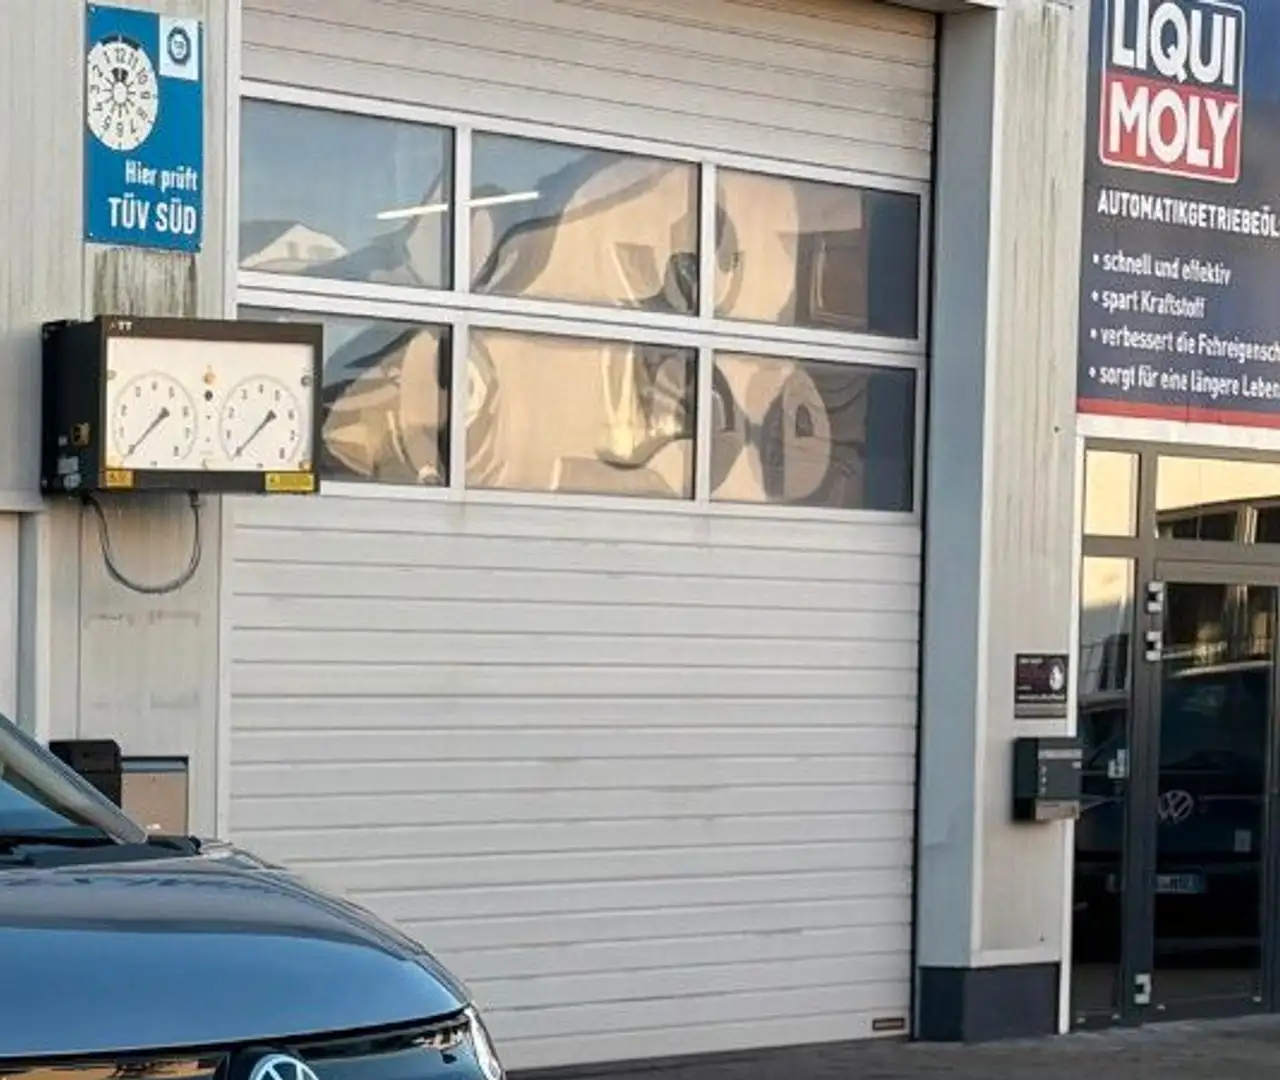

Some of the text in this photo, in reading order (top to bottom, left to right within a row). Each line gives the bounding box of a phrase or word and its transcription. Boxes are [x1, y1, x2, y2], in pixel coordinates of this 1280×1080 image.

[1112, 0, 1237, 86] LIQUI
[1108, 81, 1240, 169] MOLY
[125, 159, 199, 193] Hier prüft
[107, 192, 197, 235] TÜV SÜD
[1102, 249, 1231, 285] schnell und effektiv
[1101, 289, 1206, 319] spart Kraftstoff
[1100, 324, 1174, 352] verbessert
[1176, 330, 1196, 355] die
[1099, 365, 1135, 392] sorgt
[1138, 364, 1159, 389] für
[1160, 367, 1188, 391] eine
[1190, 369, 1240, 400] längere
